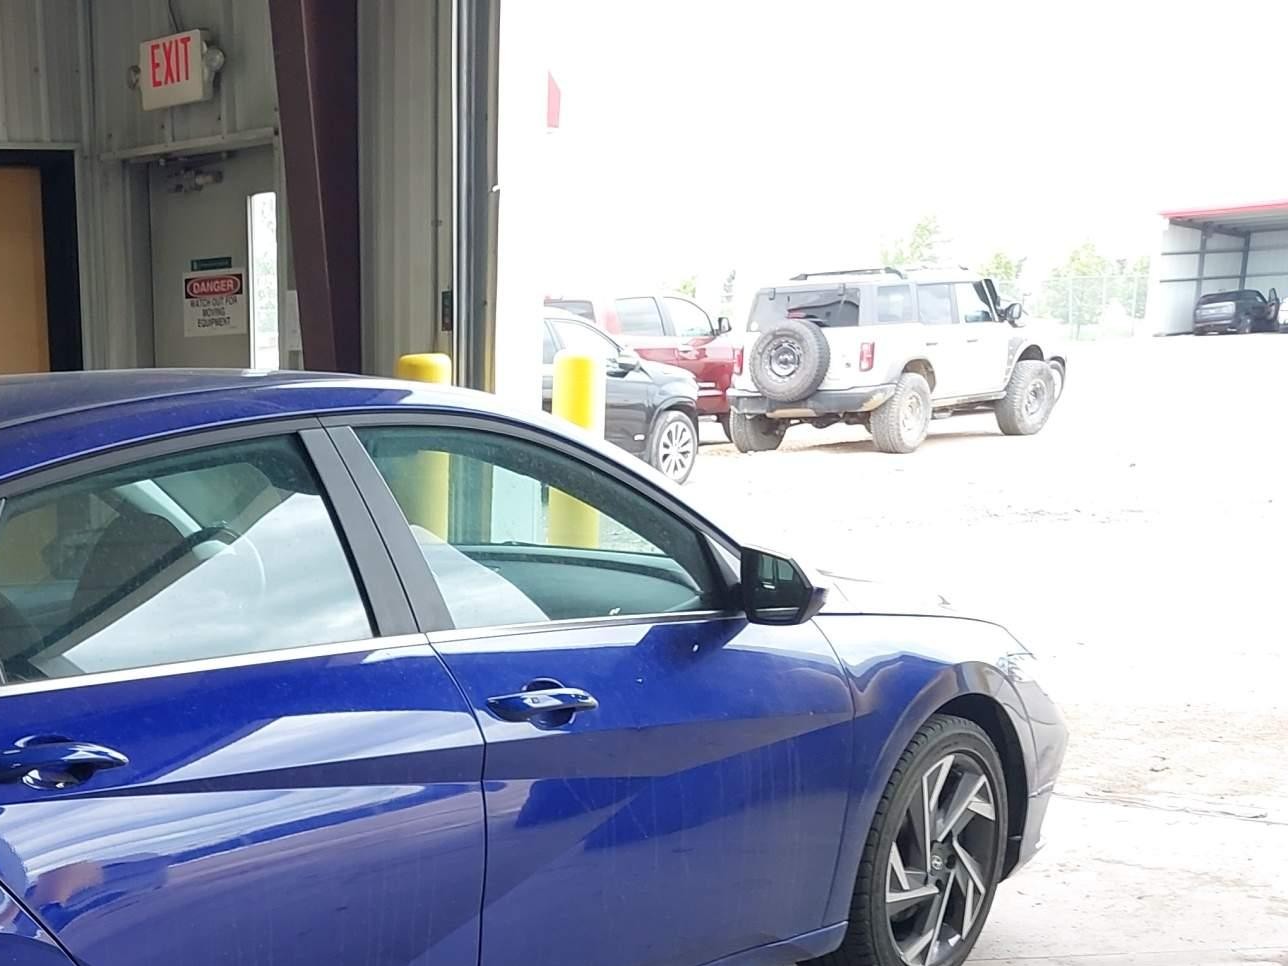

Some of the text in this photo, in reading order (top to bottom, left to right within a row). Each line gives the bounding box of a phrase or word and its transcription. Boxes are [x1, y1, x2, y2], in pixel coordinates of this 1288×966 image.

[150, 36, 192, 88] EXIT
[192, 279, 234, 294] DANGER
[190, 295, 238, 307] WATCH OUT FOR
[202, 307, 226, 317] MOVING
[197, 317, 231, 328] EQUIPMENT
